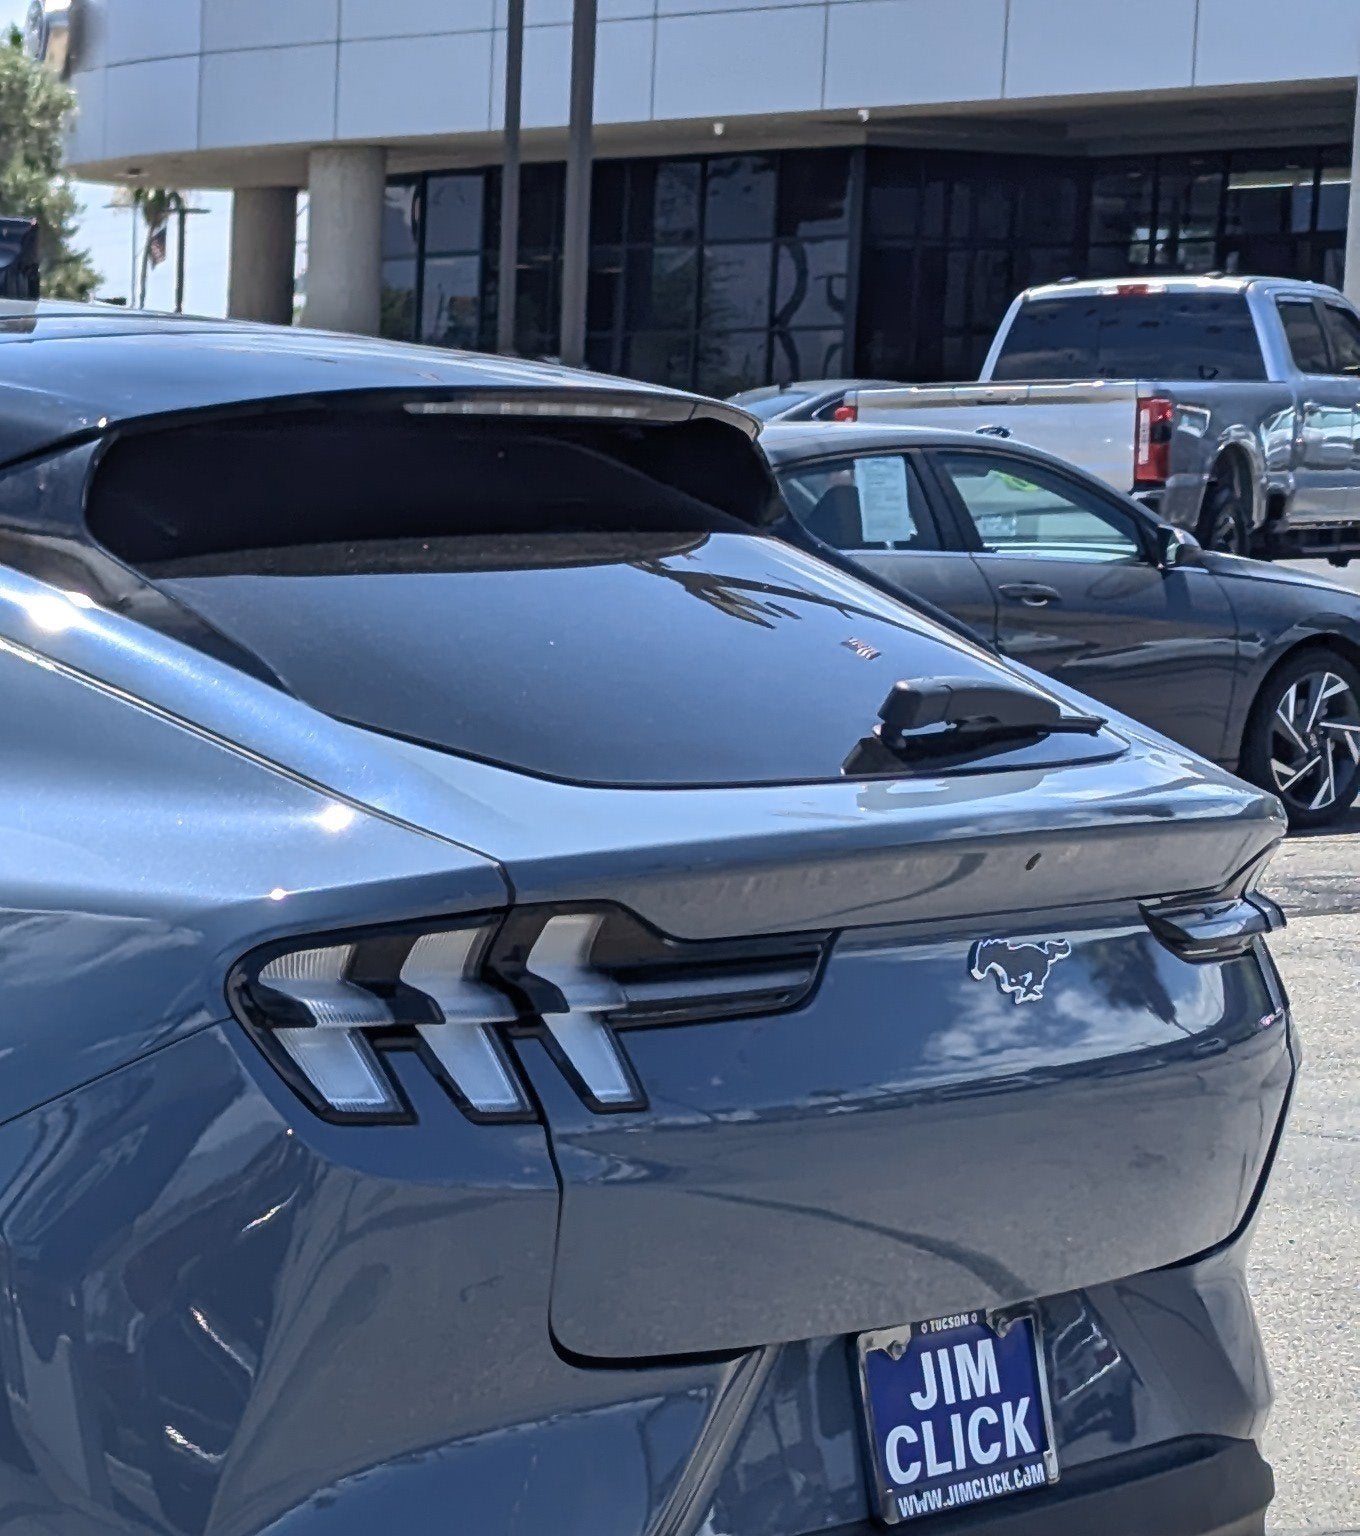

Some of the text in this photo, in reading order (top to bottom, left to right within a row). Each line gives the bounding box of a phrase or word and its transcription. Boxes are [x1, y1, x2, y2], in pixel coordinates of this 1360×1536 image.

[930, 1313, 970, 1334] TUCSON
[910, 1338, 1001, 1411] JIM
[885, 1396, 1036, 1485] CLICK
[898, 1462, 1046, 1518] WWW.JIMCLICK.COM
